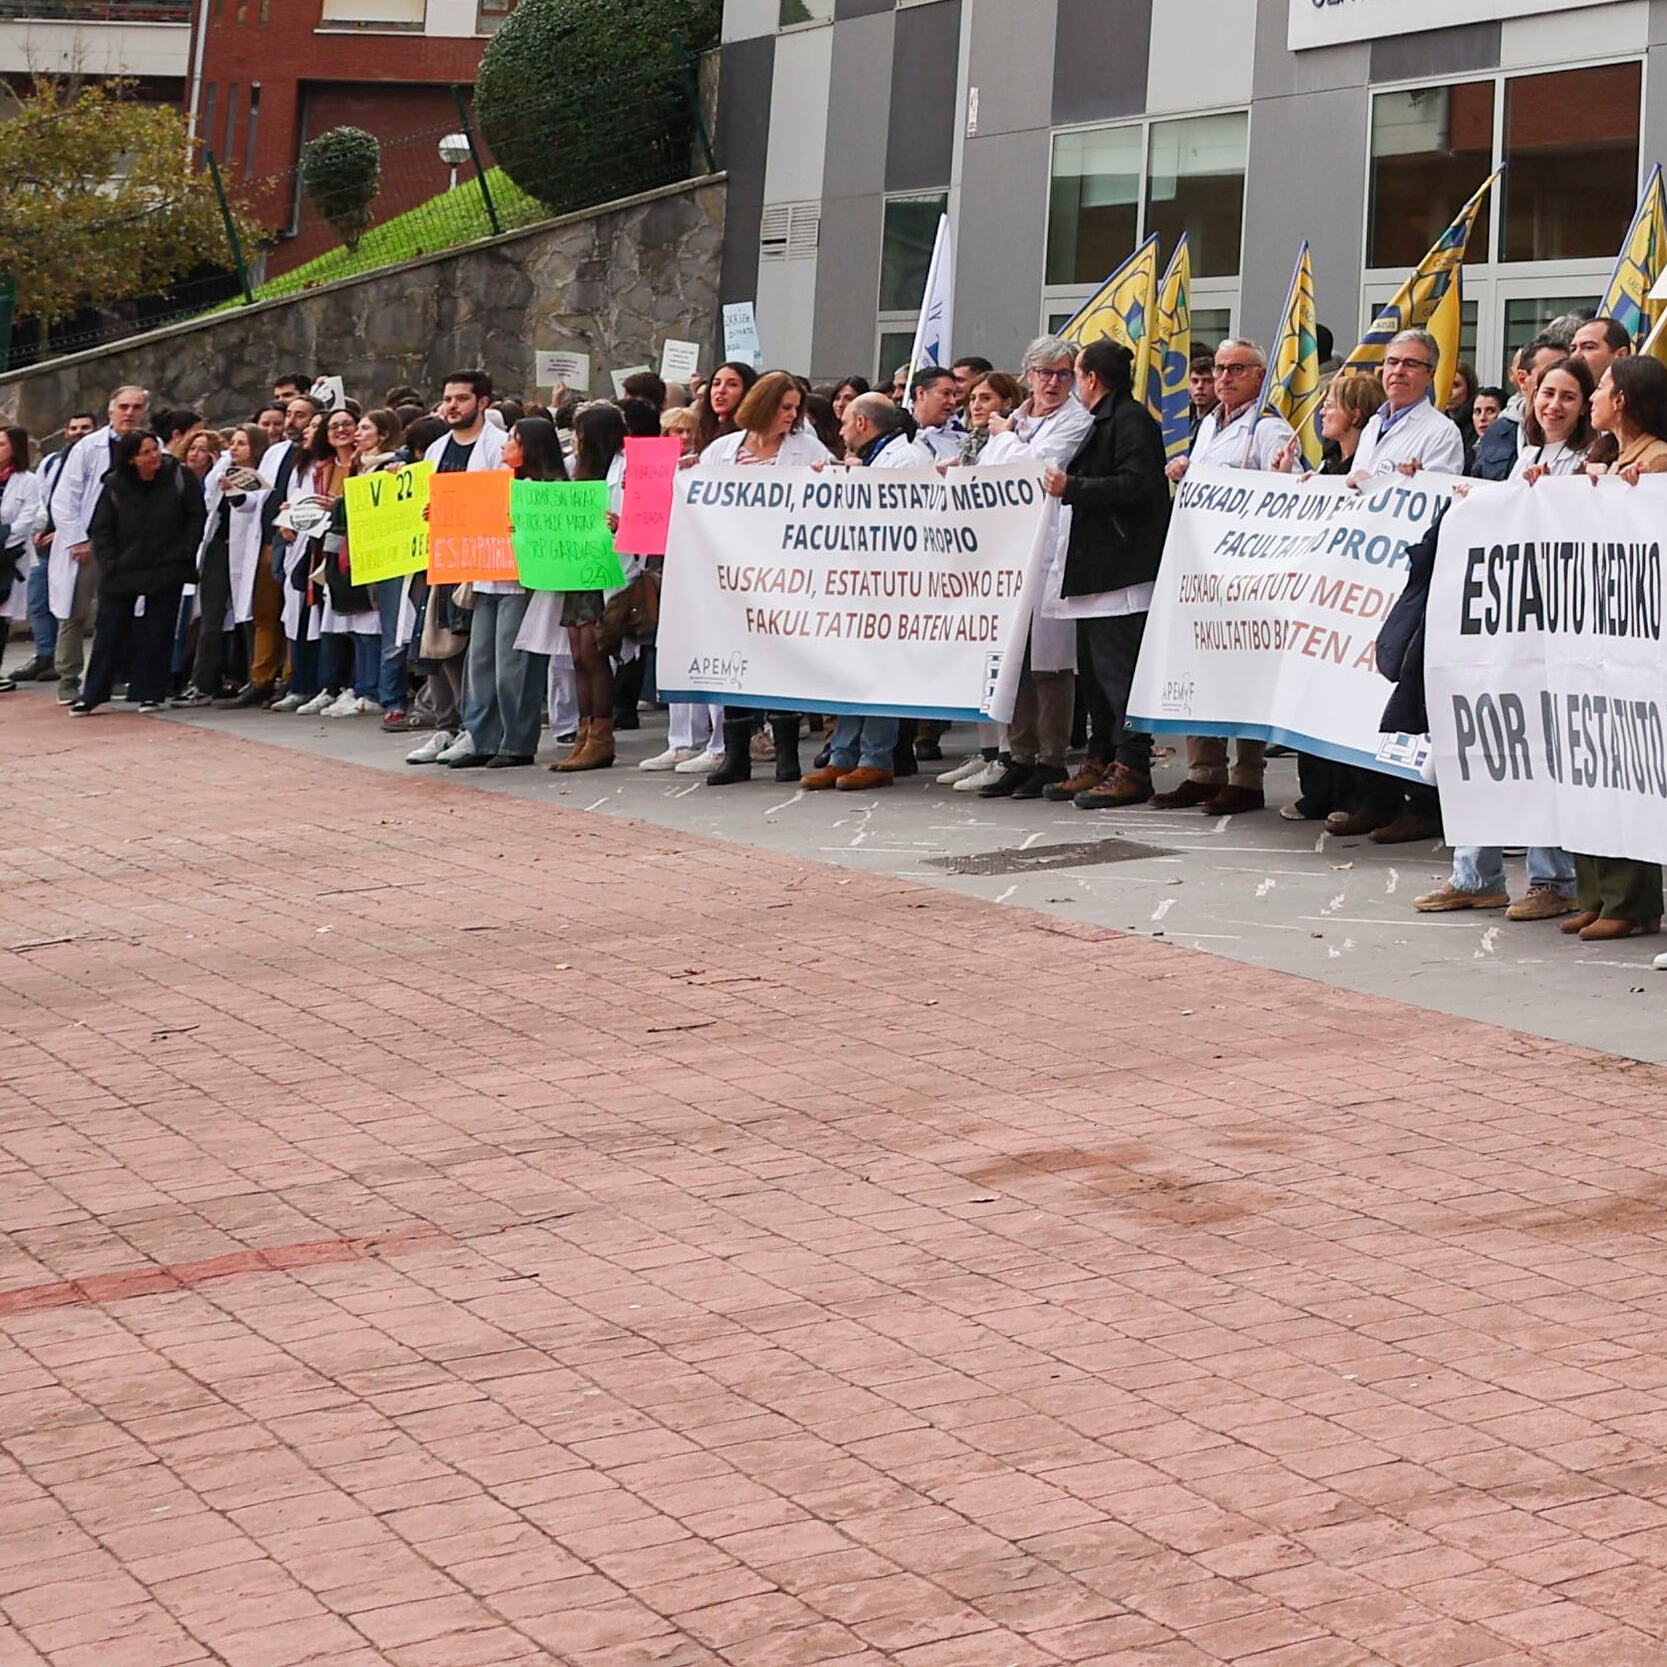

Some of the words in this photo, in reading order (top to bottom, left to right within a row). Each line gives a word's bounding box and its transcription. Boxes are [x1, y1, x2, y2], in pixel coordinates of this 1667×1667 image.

[687, 480, 795, 512] EUSKADI,
[802, 482, 844, 509] POR
[846, 483, 872, 510] UN
[952, 476, 1034, 511] MÉDICO
[1179, 482, 1250, 519] EUSKADI,
[1254, 491, 1300, 520] POR
[1299, 494, 1332, 521] UN
[782, 524, 917, 552] FACULTATIVO
[924, 527, 978, 554] PROPIO
[717, 565, 817, 599] EUSKADI,
[825, 569, 922, 597] ESTATUTU
[928, 570, 992, 598] MEDIKO
[997, 570, 1023, 598] ETA
[1179, 574, 1224, 606] EUSKADI,
[1226, 572, 1312, 602] ESTATUTU
[1310, 575, 1395, 622] MEDI
[1592, 542, 1661, 641] MEDIKO
[746, 608, 892, 639] FAKULTATIBO
[898, 614, 953, 642] BATEN
[955, 615, 998, 642] ALDE
[1194, 620, 1270, 650] FAKULTATIBO
[1452, 692, 1533, 782] POR
[1566, 693, 1667, 799] ESTATUTO
